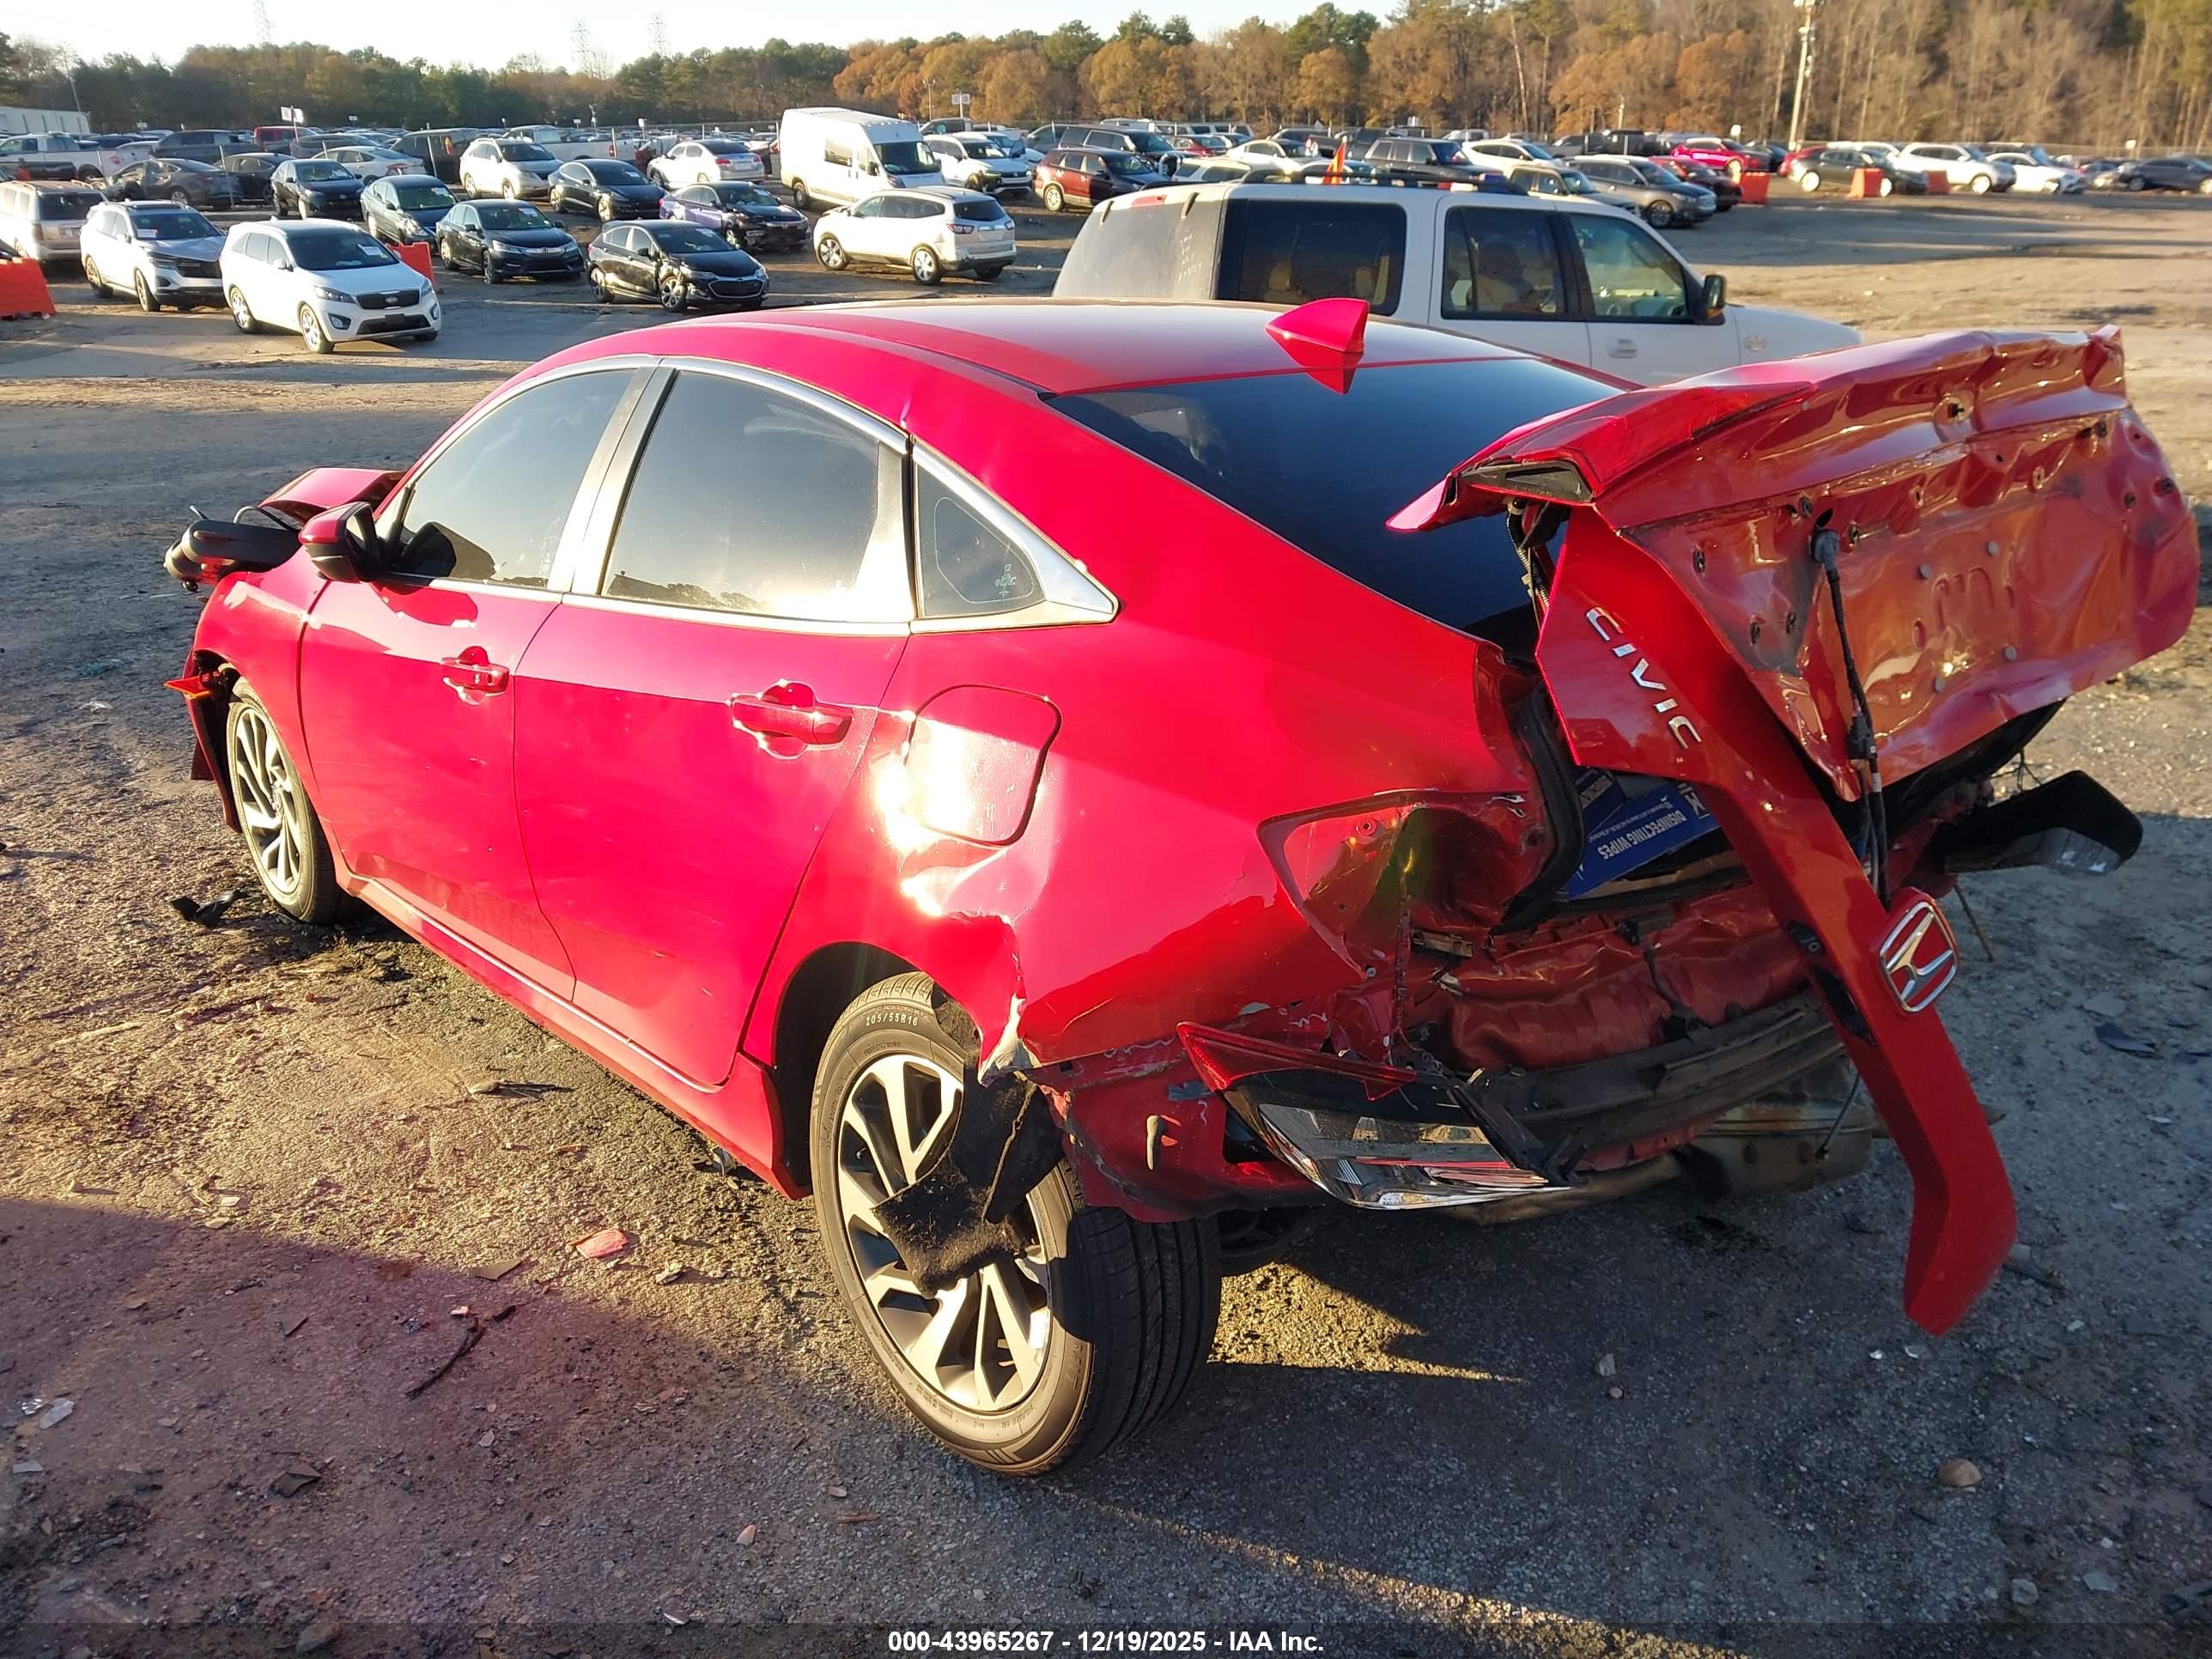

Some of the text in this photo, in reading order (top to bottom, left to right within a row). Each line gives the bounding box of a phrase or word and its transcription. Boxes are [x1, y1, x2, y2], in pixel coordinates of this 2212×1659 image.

[1585, 606, 1703, 750] CIVIC
[1626, 810, 1687, 846] DISINFECTING
[1597, 836, 1633, 860] WIPES
[866, 1012, 919, 1027] 205/55R16
